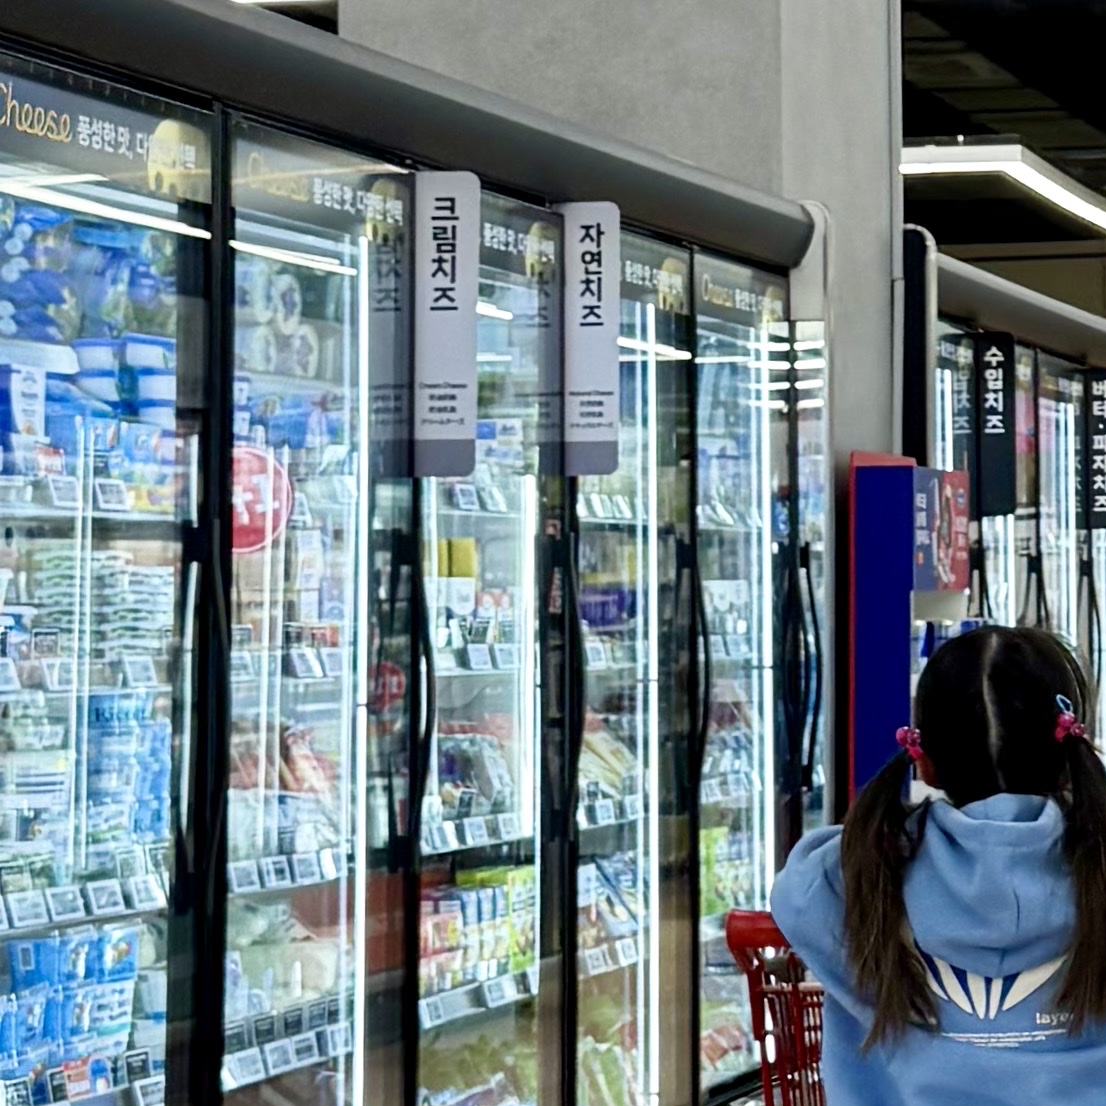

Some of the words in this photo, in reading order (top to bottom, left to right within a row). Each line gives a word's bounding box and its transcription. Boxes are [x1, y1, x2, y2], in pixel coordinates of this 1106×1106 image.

[76, 115, 116, 153] 풍성한
[430, 196, 460, 312] 크림치즈
[579, 222, 606, 327] 자연치즈
[983, 345, 1006, 435] 수입치즈
